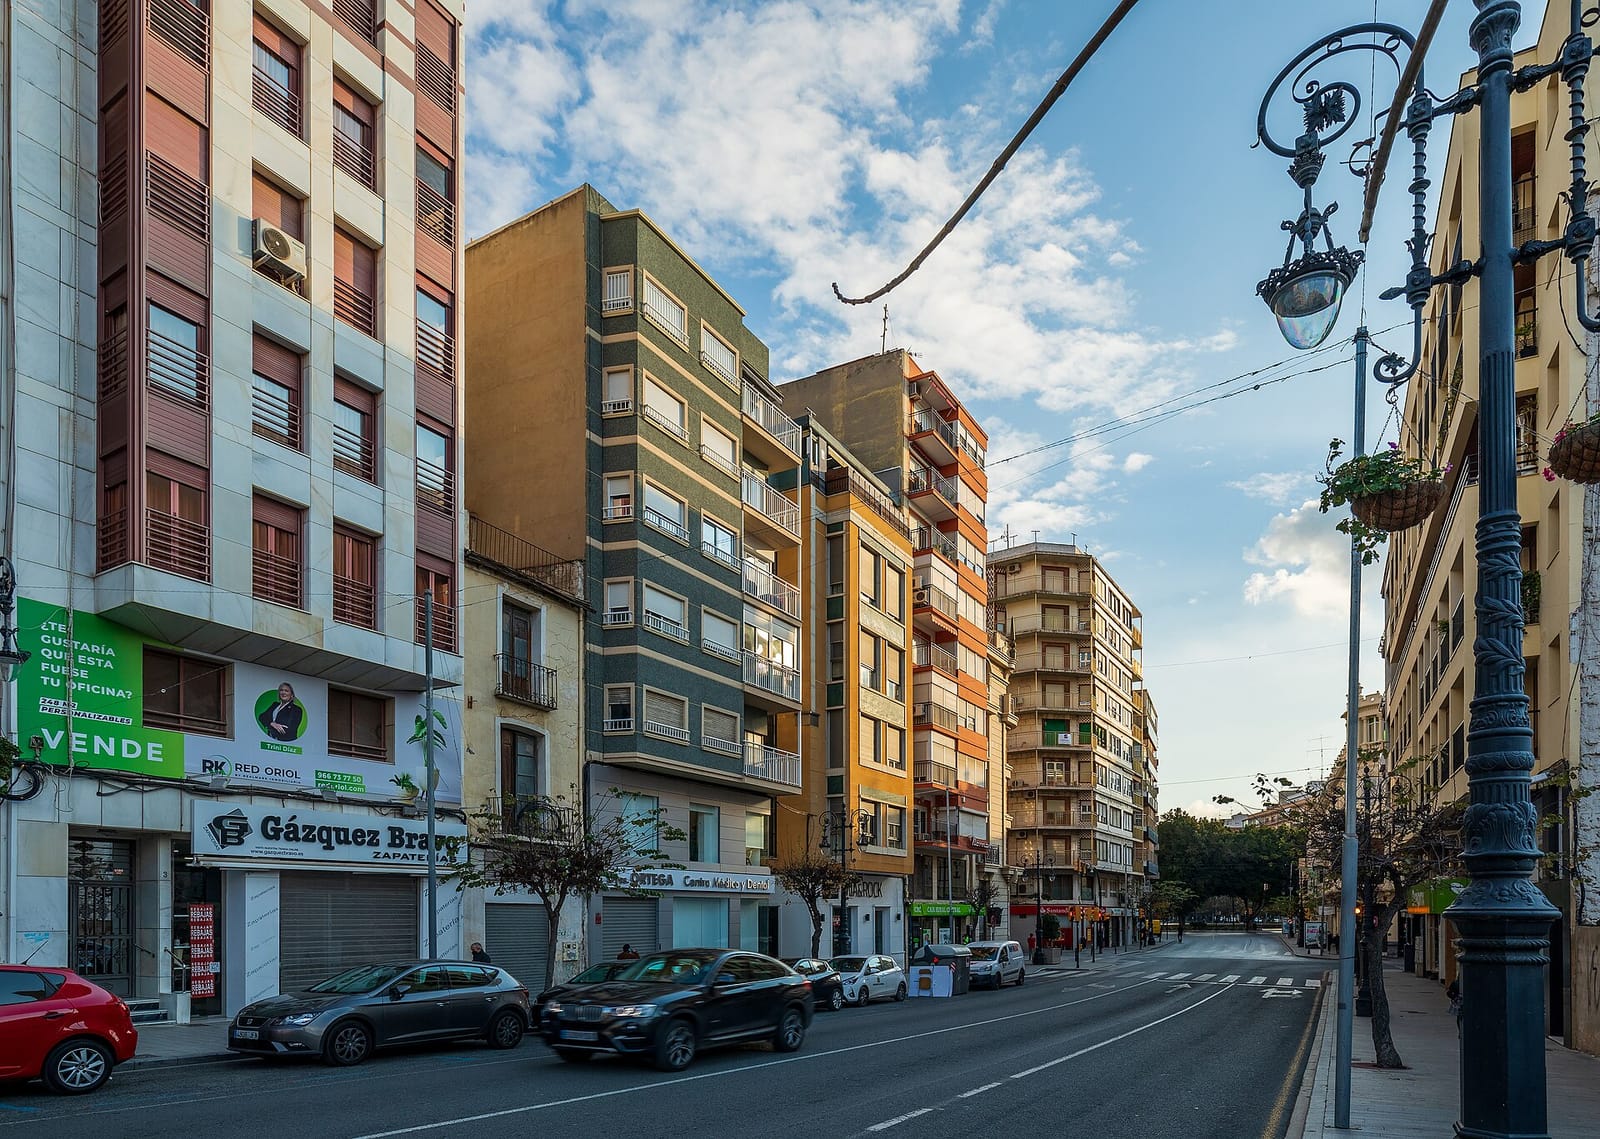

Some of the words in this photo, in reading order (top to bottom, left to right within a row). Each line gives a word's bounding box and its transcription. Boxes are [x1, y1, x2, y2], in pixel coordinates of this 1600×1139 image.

[41, 621, 67, 633] ¿TE
[41, 635, 116, 657] GUSTARÍA
[41, 648, 72, 662] QU
[78, 655, 114, 669] ESTA
[41, 662, 89, 679] FUESE
[40, 676, 61, 687] TU
[66, 681, 133, 699] OFICINA?
[41, 728, 164, 762] VENDE
[266, 743, 282, 751] Trini
[202, 759, 226, 776] RK
[235, 763, 260, 774] RED
[264, 766, 301, 779] ORIOL
[317, 771, 331, 779] 966
[261, 815, 380, 850] Gázquez
[373, 851, 457, 863] ZAPATEÍAS
[162, 871, 169, 879] 3
[683, 875, 711, 888] Centro
[712, 876, 739, 889] Médico
[747, 878, 770, 890] Dental
[190, 929, 213, 937] REBAJAS
[191, 983, 214, 991] REBAJAS
